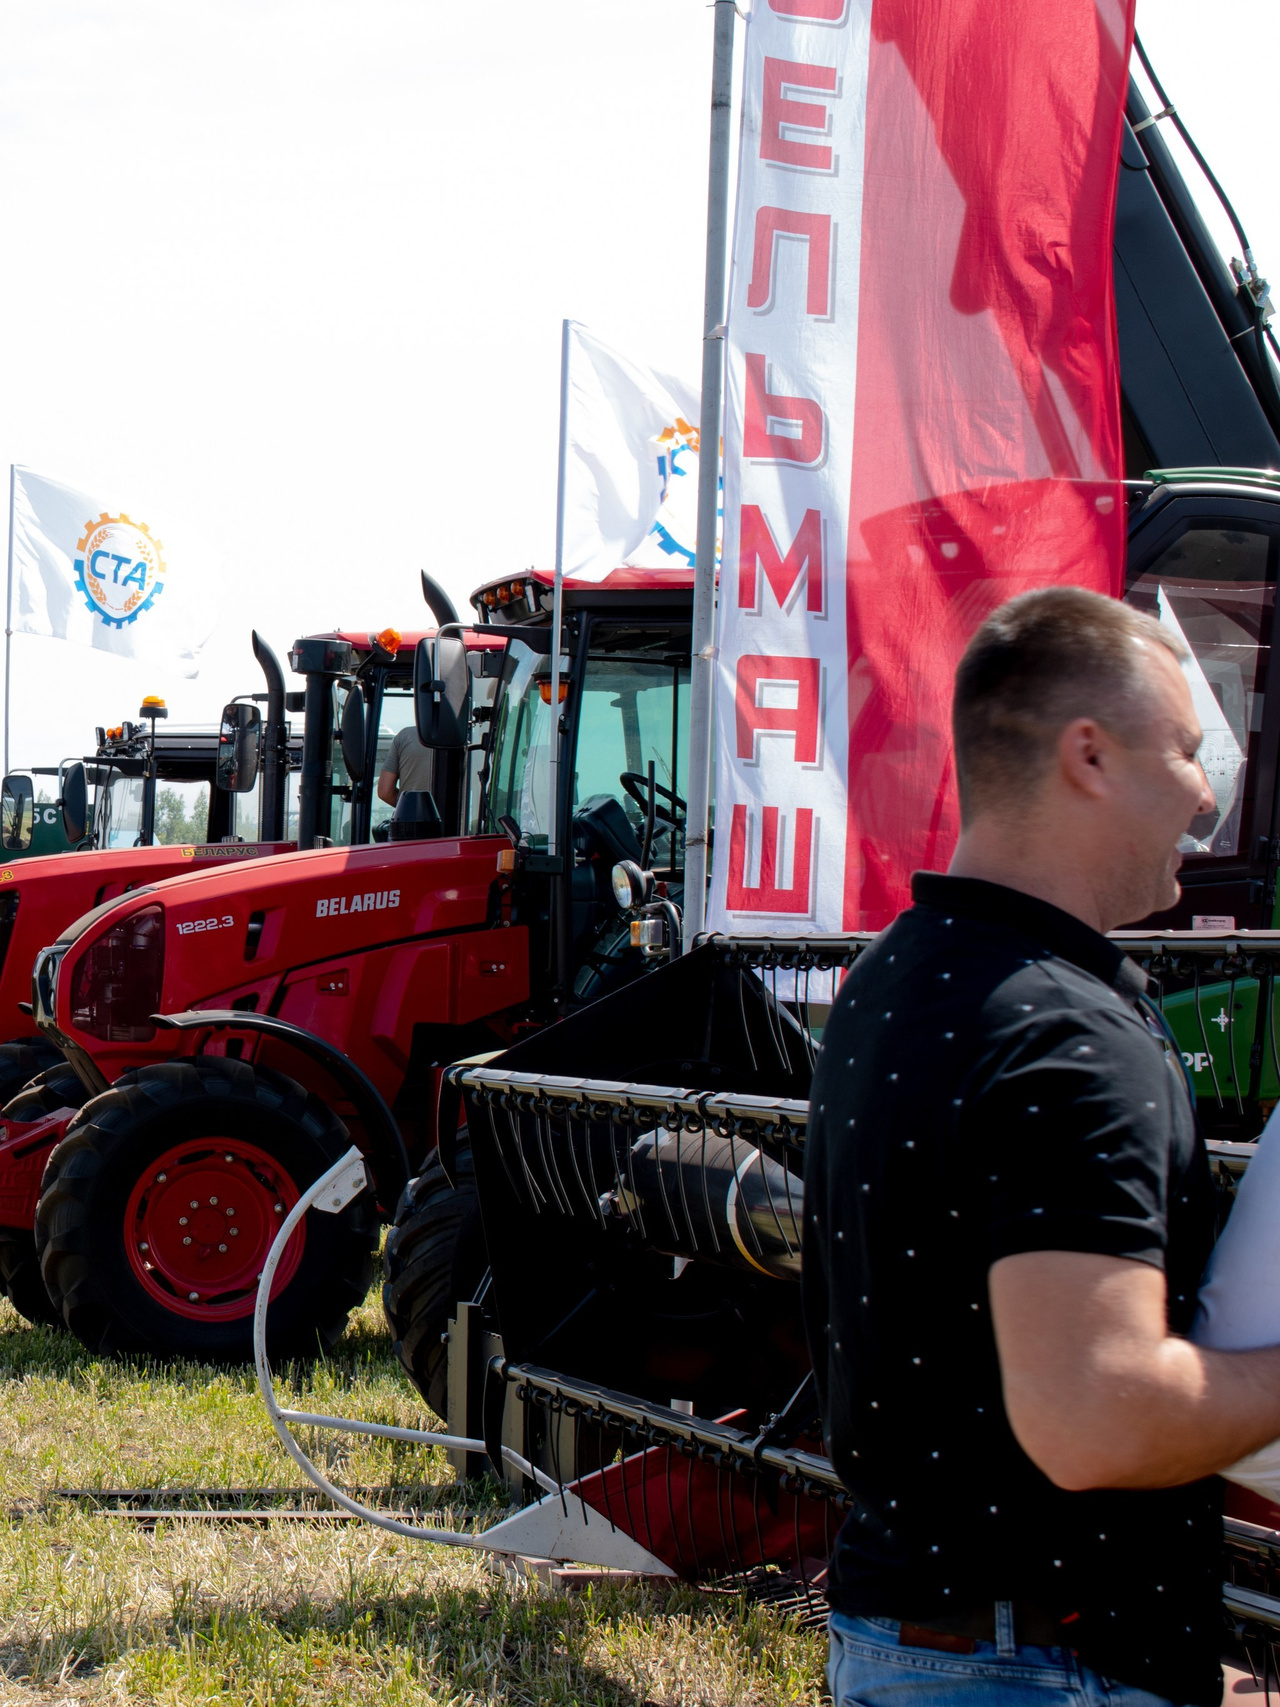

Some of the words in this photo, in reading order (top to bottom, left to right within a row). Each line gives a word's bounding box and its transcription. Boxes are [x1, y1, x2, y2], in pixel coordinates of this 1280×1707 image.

[726, 0, 849, 919] ЕЛЬМАШ
[180, 846, 258, 858] БЕЛАРУС
[315, 889, 401, 918] BELARUS
[176, 915, 235, 935] 1222.3
